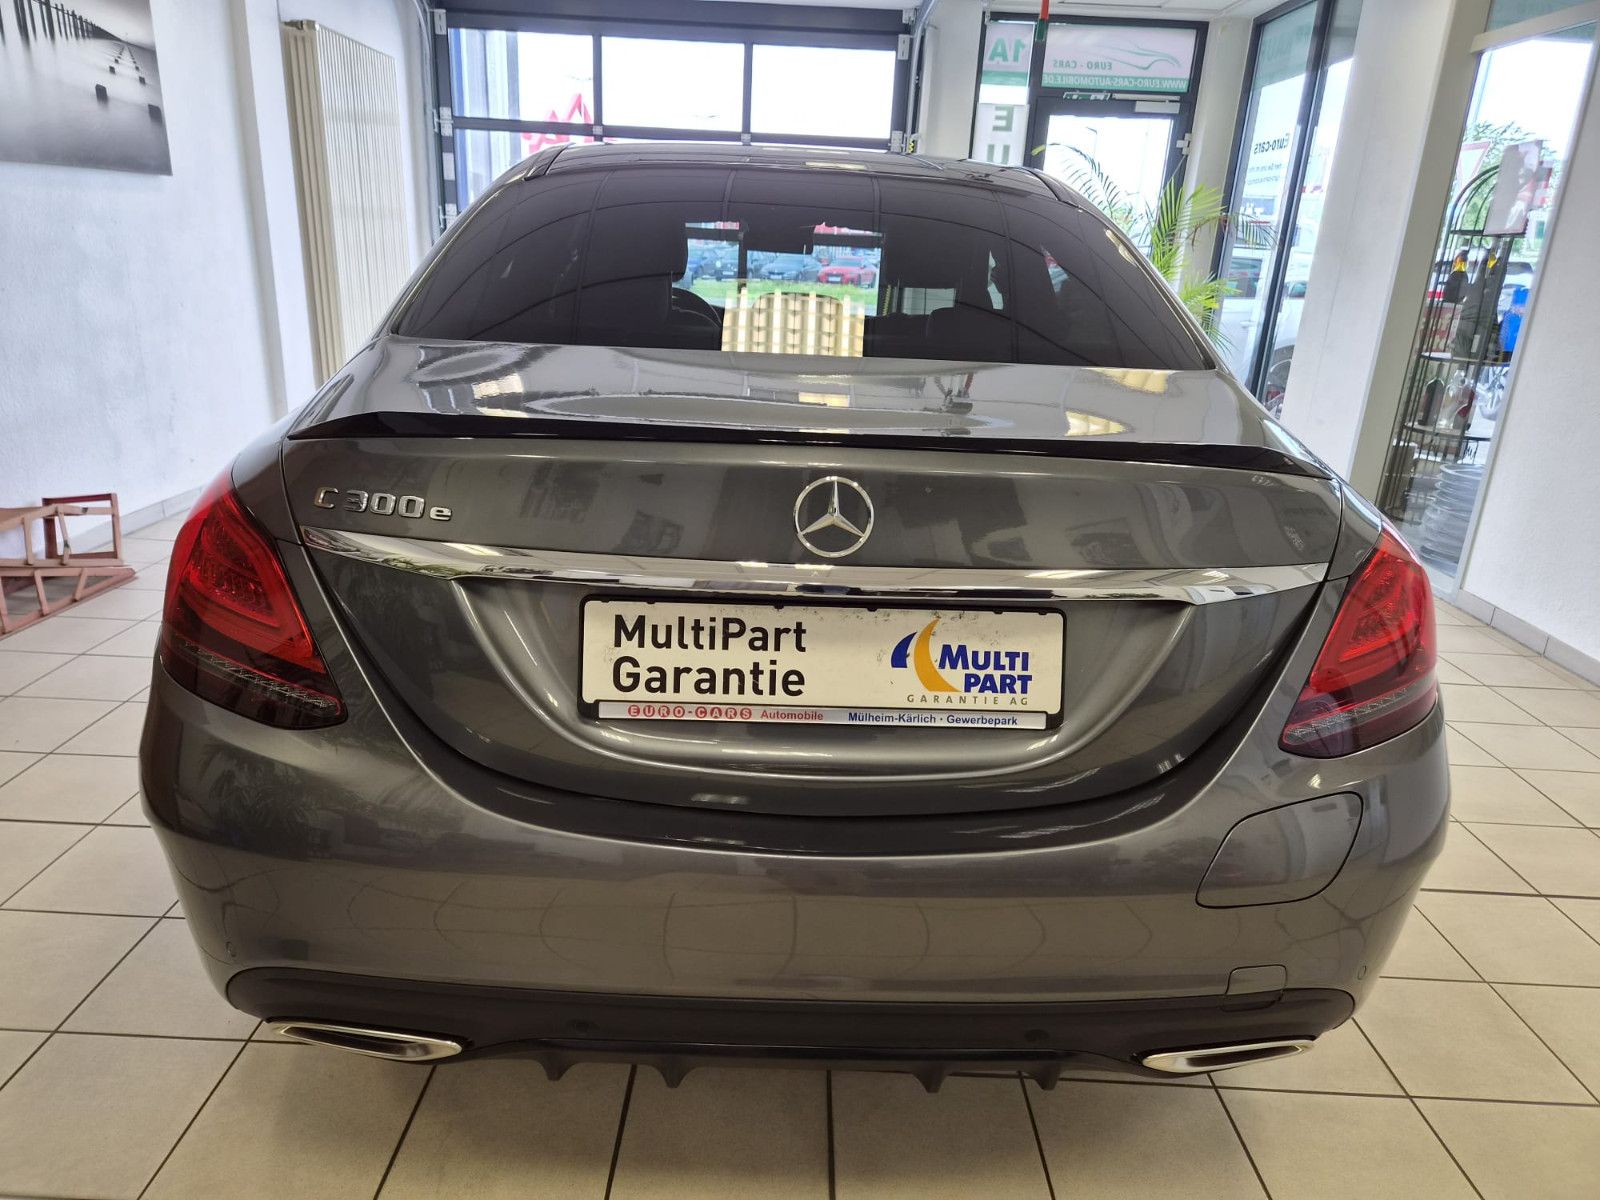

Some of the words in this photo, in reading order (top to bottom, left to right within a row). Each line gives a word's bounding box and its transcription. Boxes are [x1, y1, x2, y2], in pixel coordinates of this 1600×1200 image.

[314, 486, 339, 509] C
[613, 614, 806, 652] MultiPart
[938, 644, 1030, 671] MULTI
[612, 655, 805, 696] Garantie
[963, 673, 1032, 694] PART
[906, 694, 999, 705] GARANTIE
[1009, 696, 1028, 706] AG
[627, 704, 753, 720] EURO-CARS
[760, 709, 824, 721] Automobile
[848, 712, 937, 724] Mülheim-Kärlich
[946, 714, 1018, 727] Gewerbepark
